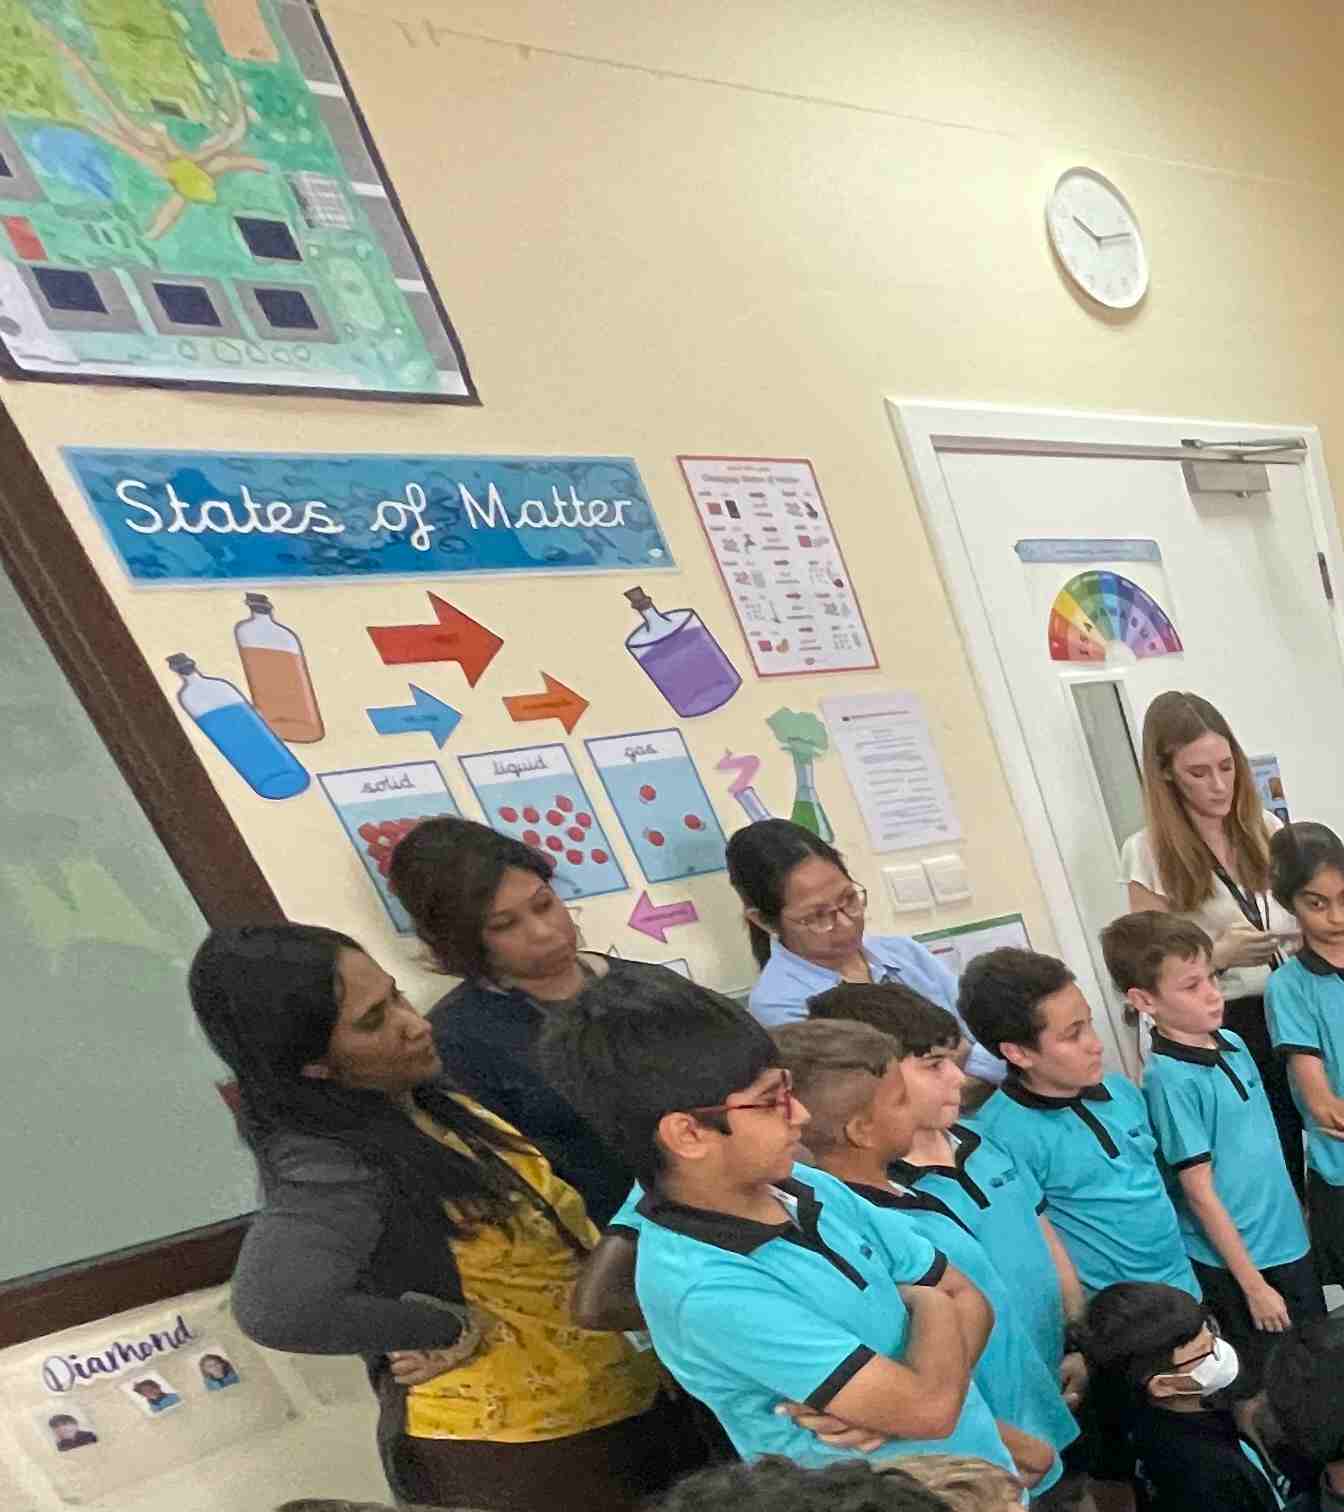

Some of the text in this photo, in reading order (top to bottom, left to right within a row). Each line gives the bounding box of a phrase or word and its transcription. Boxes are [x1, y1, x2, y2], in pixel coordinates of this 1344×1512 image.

[116, 479, 633, 551] States of Matter
[624, 741, 659, 762] gas
[492, 753, 548, 778] liquid
[360, 772, 416, 794] solid
[43, 1314, 194, 1392] Diamond
